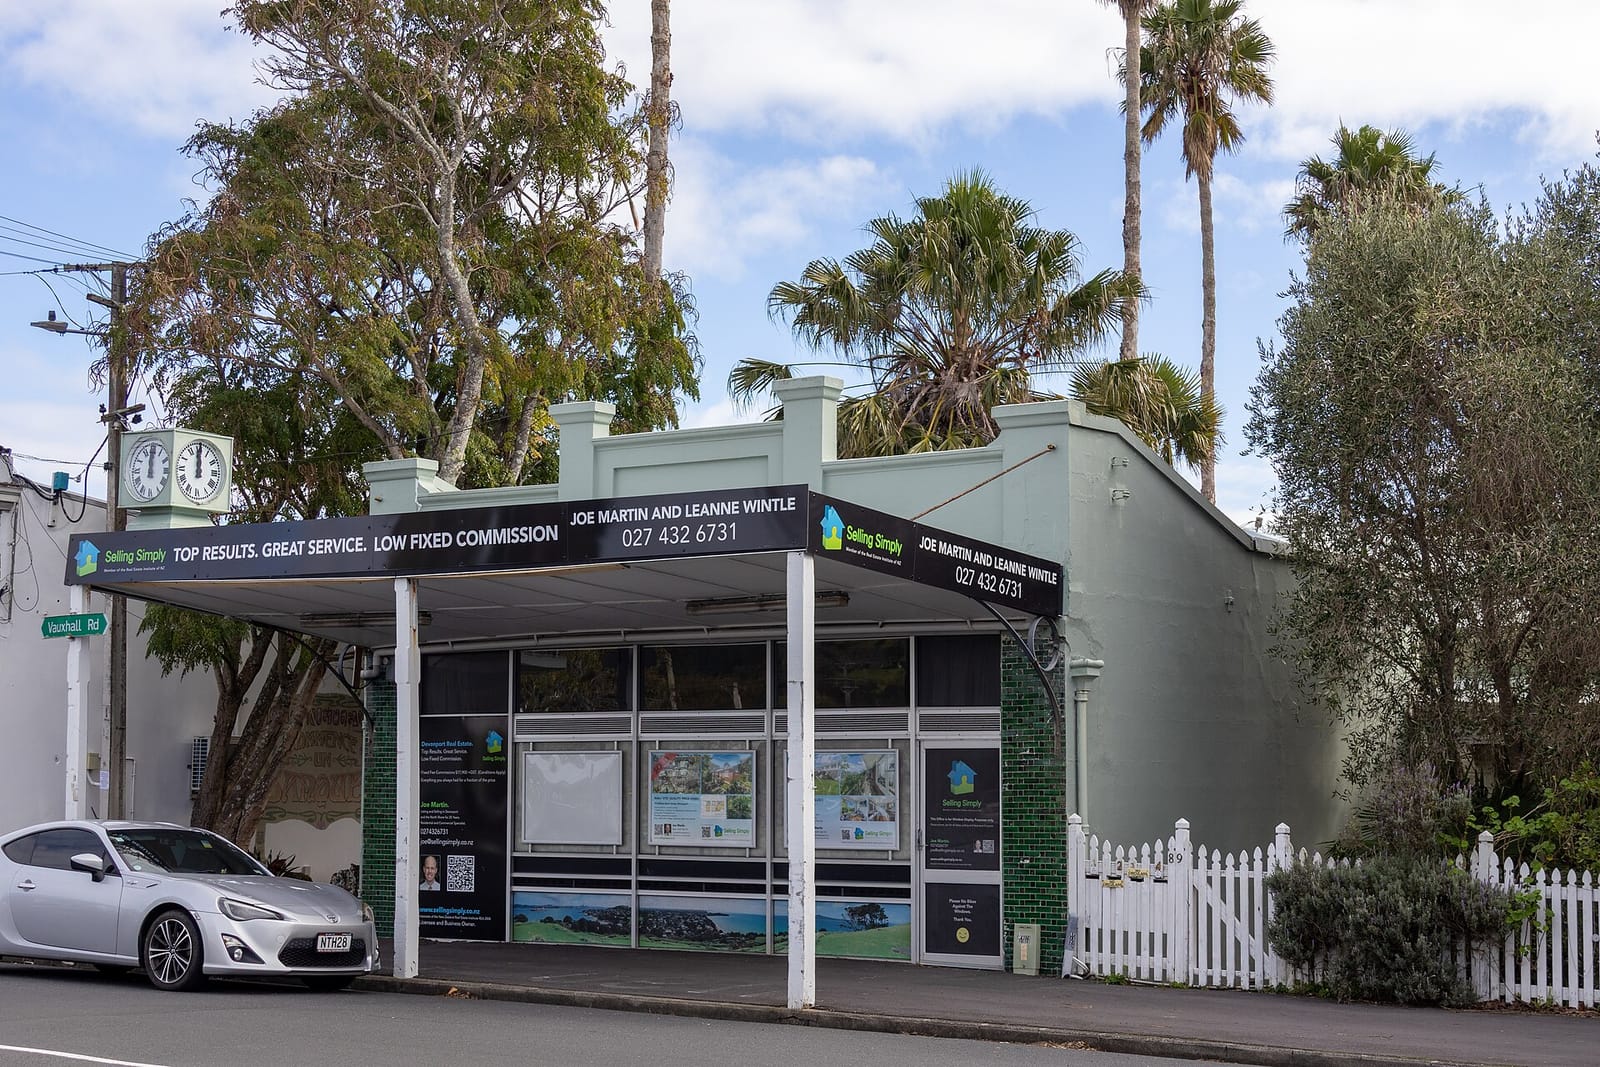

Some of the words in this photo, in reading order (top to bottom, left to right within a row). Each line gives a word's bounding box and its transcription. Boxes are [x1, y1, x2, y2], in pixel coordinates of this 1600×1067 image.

[570, 512, 594, 525] JOE
[599, 508, 648, 523] MARTIN
[652, 506, 681, 520] AND
[686, 501, 739, 517] LEANNE
[743, 497, 795, 513] WINTLE
[374, 535, 407, 551] LOW
[411, 533, 452, 549] FIXED
[456, 525, 558, 546] COMMISSION
[623, 528, 652, 547] 027
[659, 526, 689, 544] 432
[696, 522, 735, 542] 6731
[846, 525, 873, 549] Selling
[875, 534, 902, 556] Simply
[105, 550, 134, 564] Selling
[136, 548, 166, 563] Simply
[174, 547, 199, 561] TOP
[203, 544, 258, 560] RESULTS.
[262, 541, 304, 557] GREAT
[308, 537, 366, 554] SERVICE.
[920, 536, 936, 552] JOE
[938, 541, 972, 562] MARTIN
[973, 551, 992, 568] AND
[994, 556, 1026, 578] LEANNE
[1028, 566, 1057, 584] WINTLE
[956, 566, 975, 586] 027
[977, 572, 996, 592] 432
[999, 580, 1022, 599] 6731
[48, 620, 82, 633] Vauxhall
[88, 619, 99, 630] Rd
[962, 800, 981, 808] Simply
[320, 937, 348, 948] NTH28
